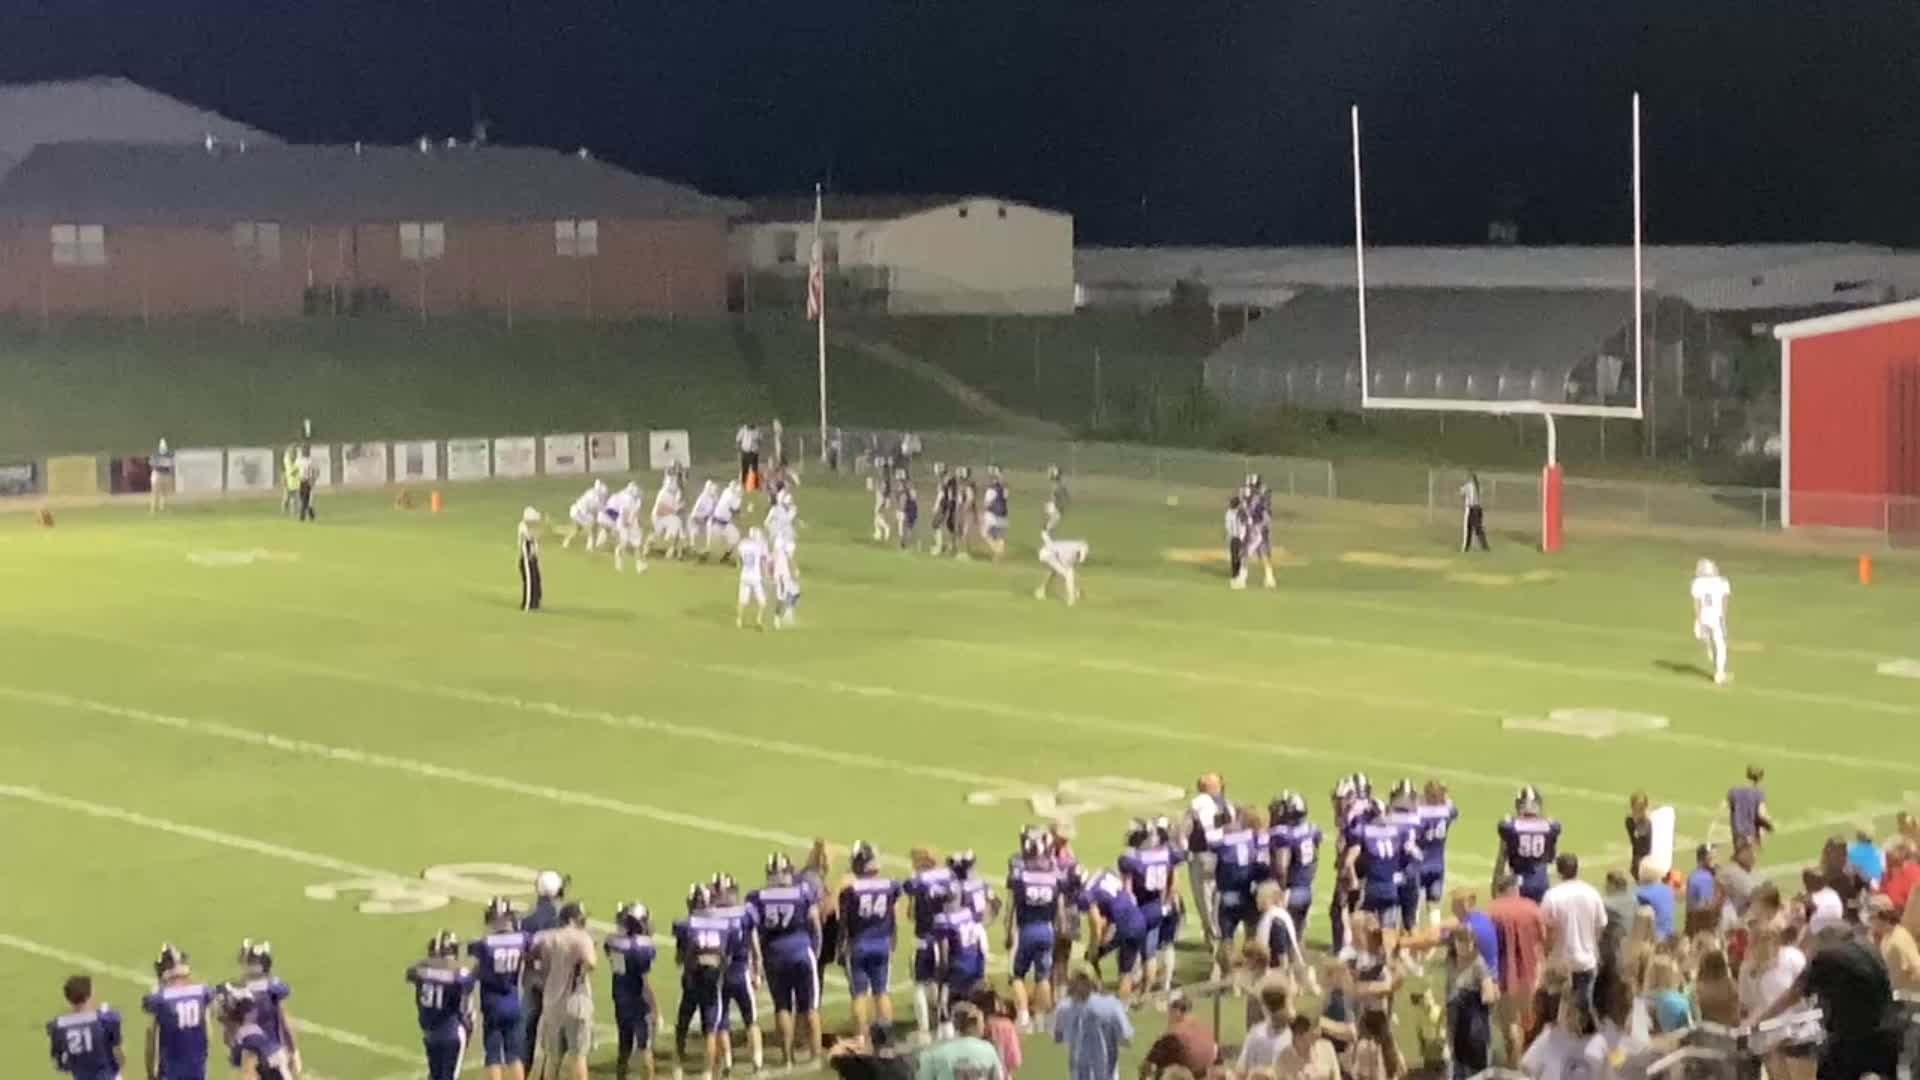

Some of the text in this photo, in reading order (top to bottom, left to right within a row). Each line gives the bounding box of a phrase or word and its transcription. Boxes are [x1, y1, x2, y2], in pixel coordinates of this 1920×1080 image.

[304, 862, 540, 914] 30
[175, 999, 201, 1029] 10
[66, 1028, 92, 1055] 21
